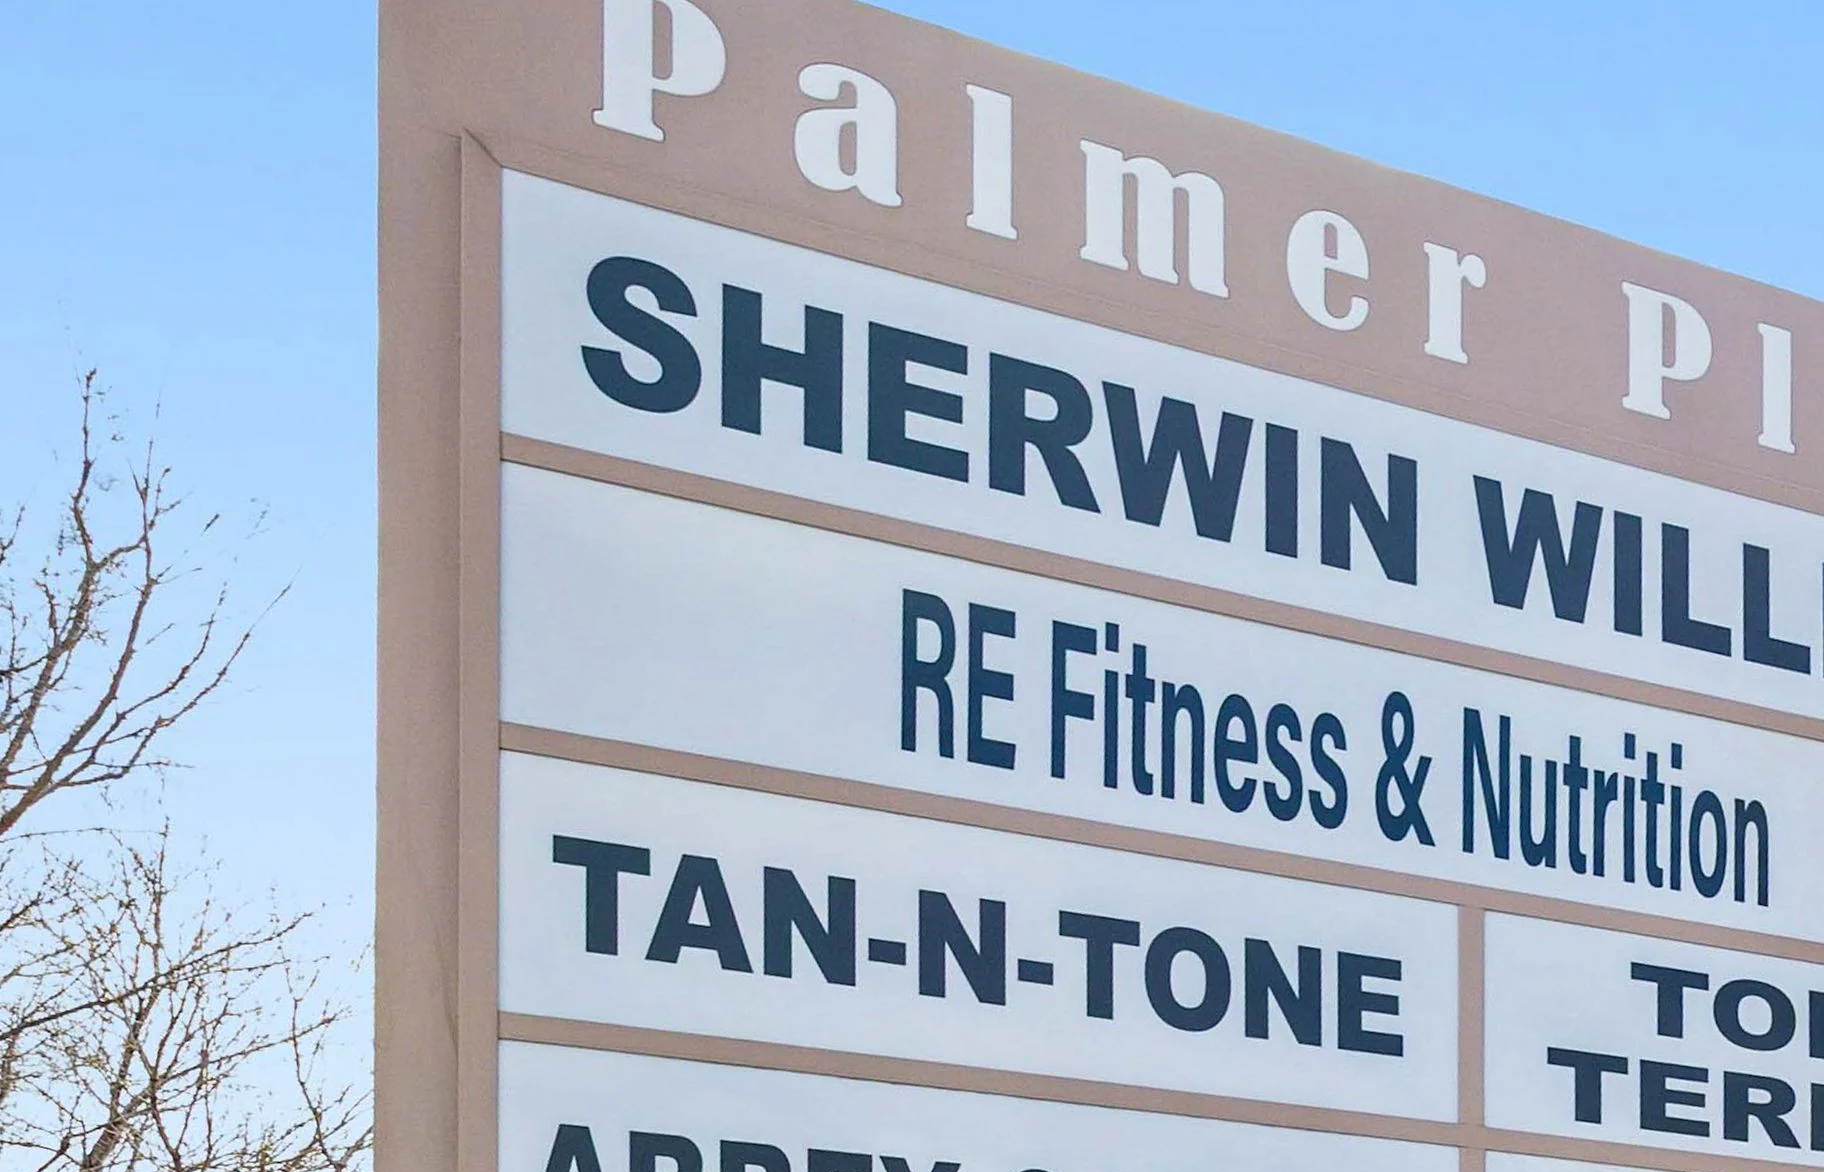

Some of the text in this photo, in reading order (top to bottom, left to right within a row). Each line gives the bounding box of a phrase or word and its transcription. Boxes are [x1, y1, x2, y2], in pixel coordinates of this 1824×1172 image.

[592, 0, 1487, 364] Palmer
[581, 256, 1418, 586] SHERWIN
[902, 588, 1769, 907] RE Fitness & Nutrition
[552, 834, 1404, 1058] TAN-N-TONE
